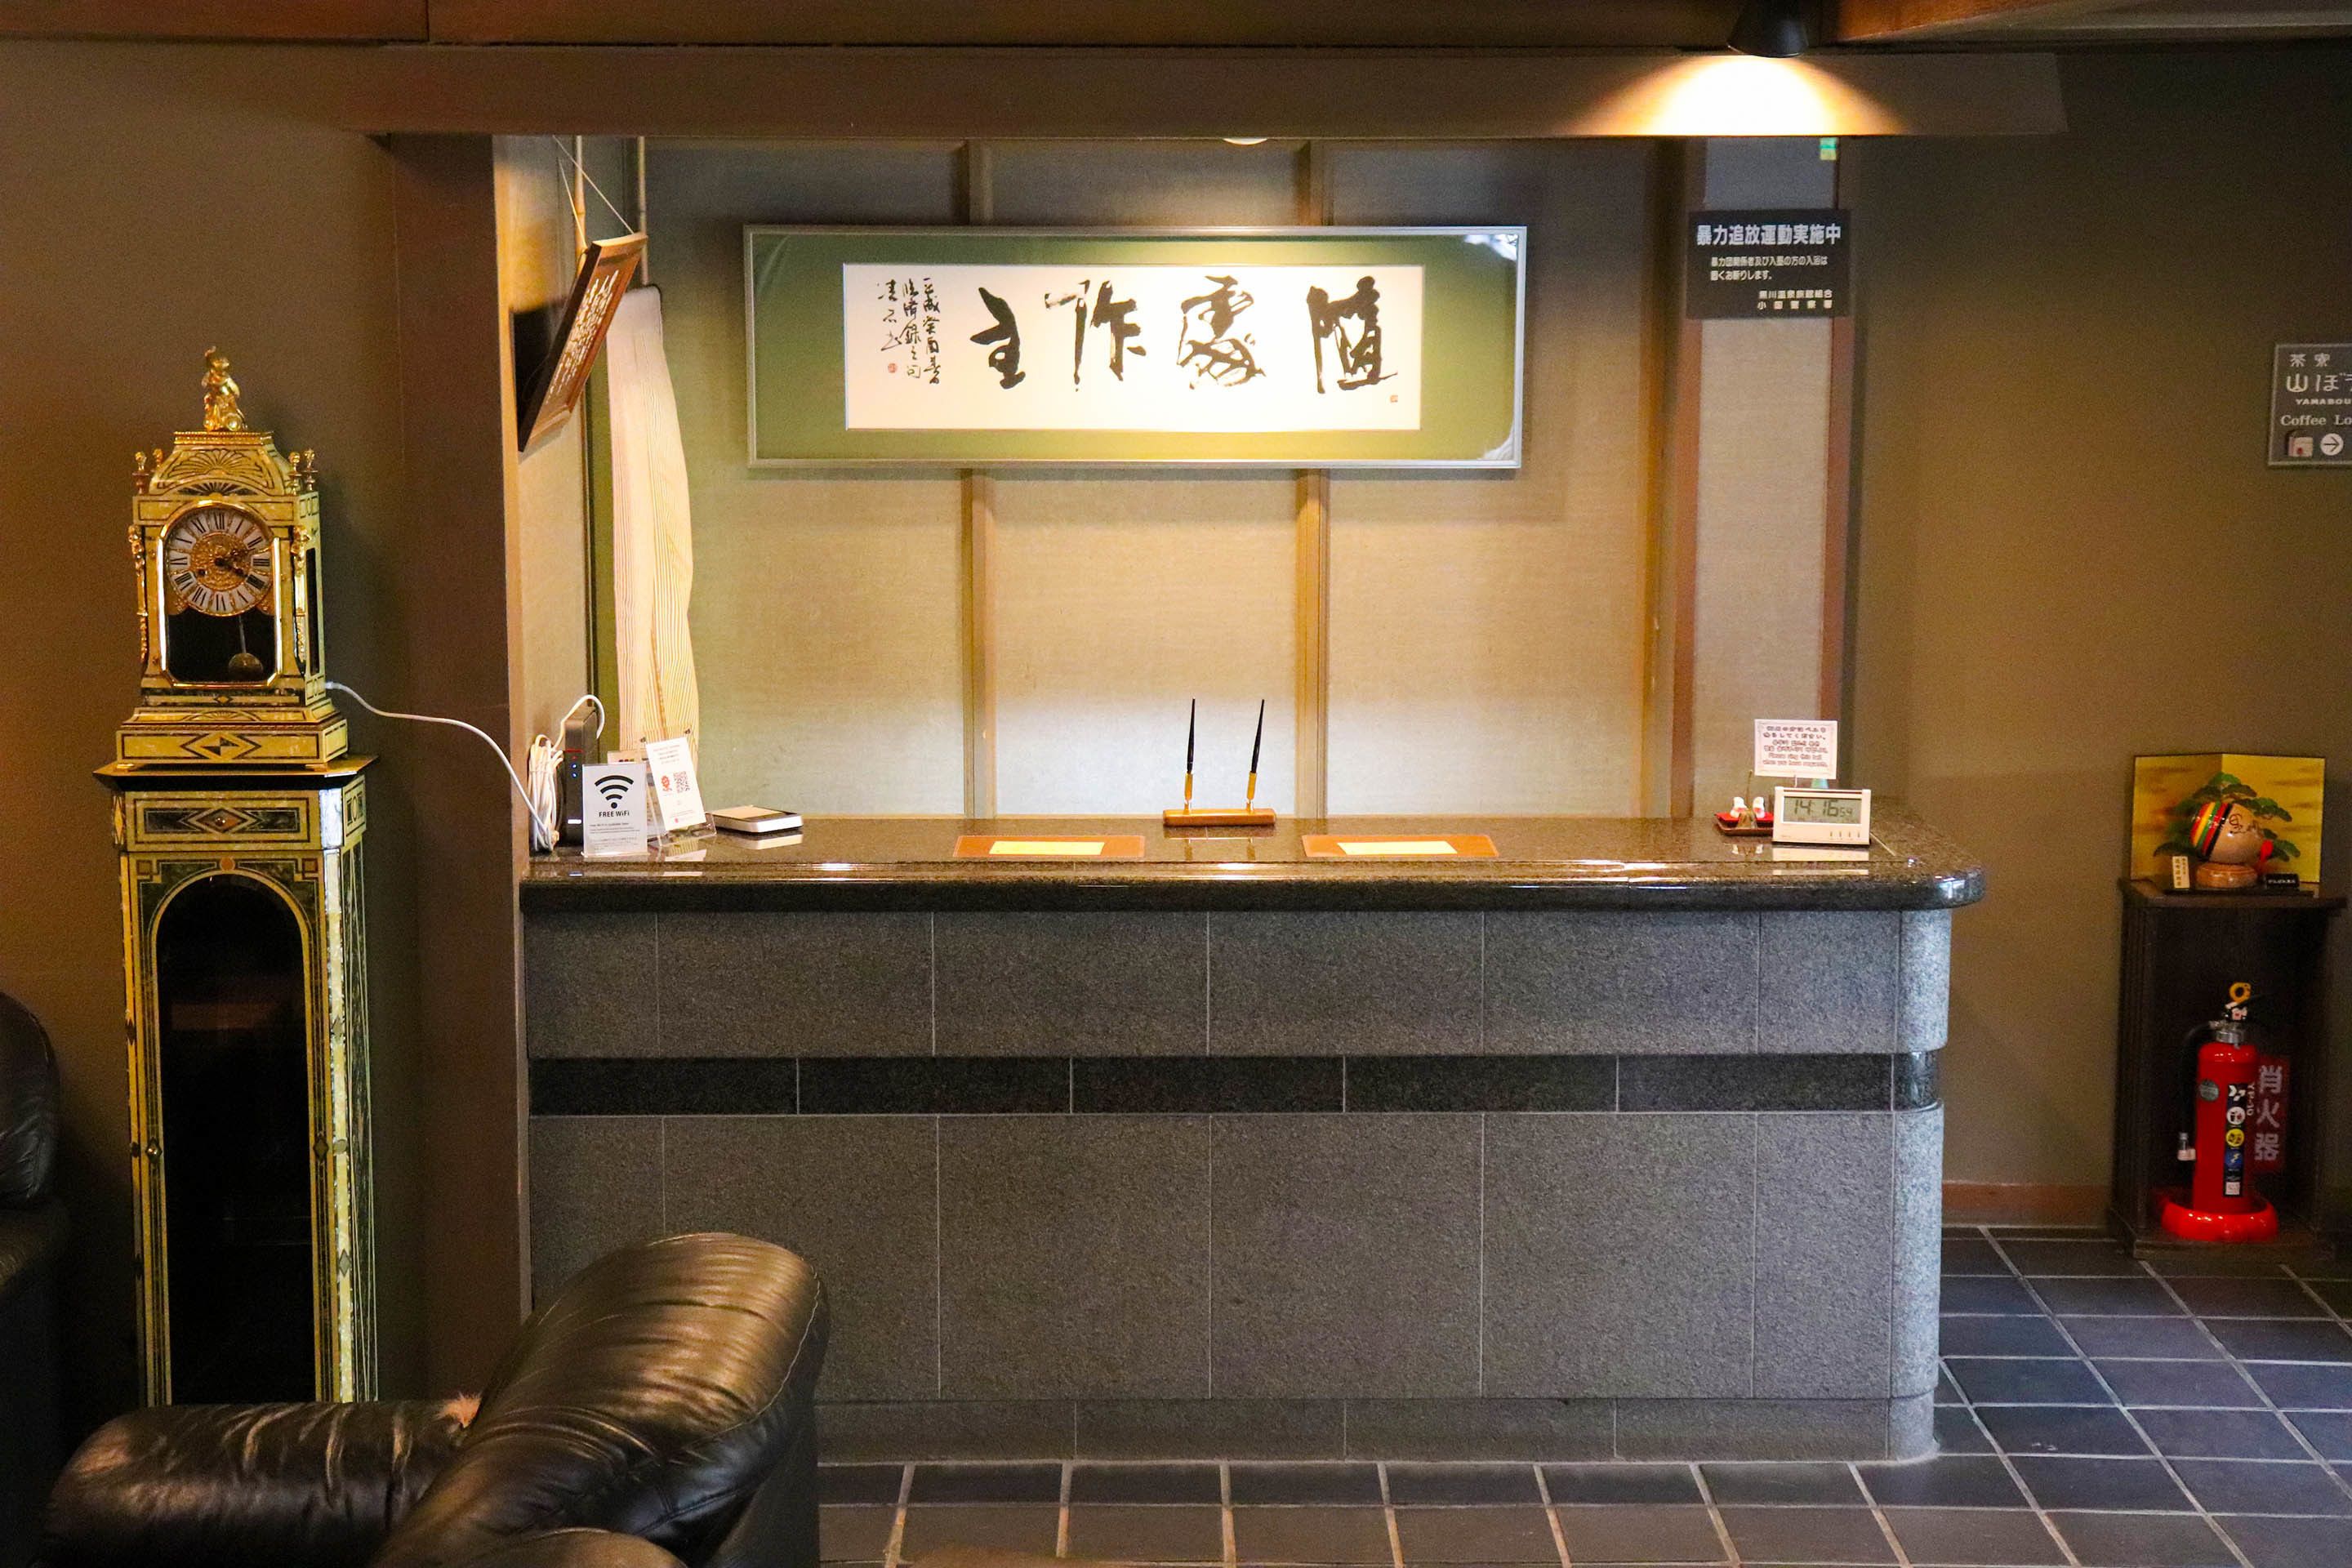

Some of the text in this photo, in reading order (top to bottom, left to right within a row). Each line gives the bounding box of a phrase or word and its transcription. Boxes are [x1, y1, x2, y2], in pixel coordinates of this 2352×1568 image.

[1696, 224, 1842, 246] 暴力追放運動実施中
[2281, 415, 2326, 425] Coffee
[253, 558, 271, 567] III
[2255, 1064, 2283, 1161] 消火器
